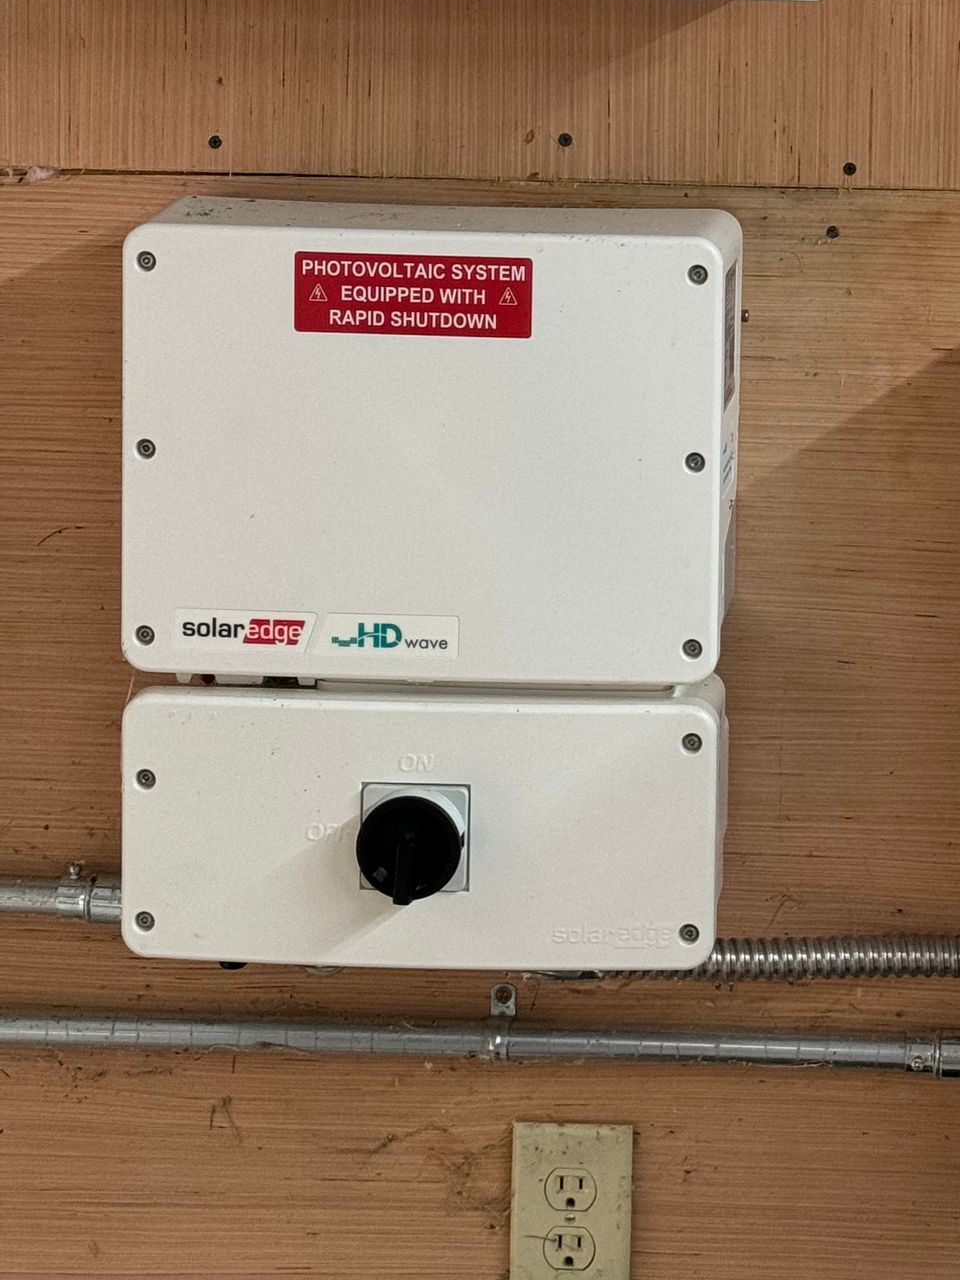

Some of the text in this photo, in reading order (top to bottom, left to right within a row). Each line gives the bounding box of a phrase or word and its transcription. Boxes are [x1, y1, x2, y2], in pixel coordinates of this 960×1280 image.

[301, 259, 526, 281] PHOTOVOLTAIC SYSTEM
[340, 285, 486, 305] EQUIPPED WITH
[329, 309, 497, 329] RAPID SHUTDOWN
[182, 617, 303, 645] solaredge
[357, 622, 448, 650] HD wave
[399, 753, 436, 772] ON
